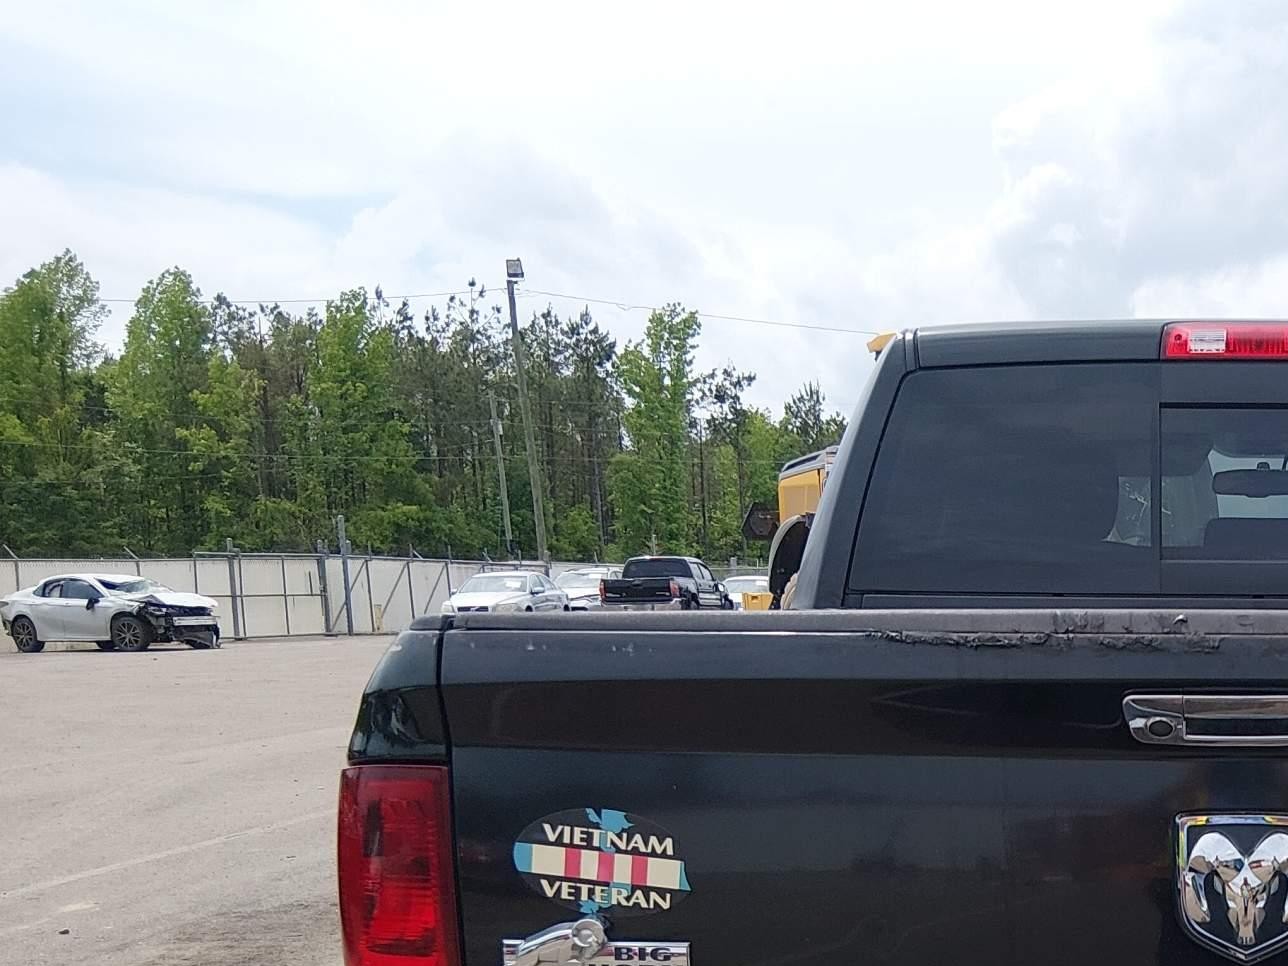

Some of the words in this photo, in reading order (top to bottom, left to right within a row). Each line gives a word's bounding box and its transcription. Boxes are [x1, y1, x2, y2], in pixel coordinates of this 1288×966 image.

[542, 823, 674, 856] VIETNAM
[540, 879, 671, 910] VETERAN
[614, 947, 673, 962] BIG
